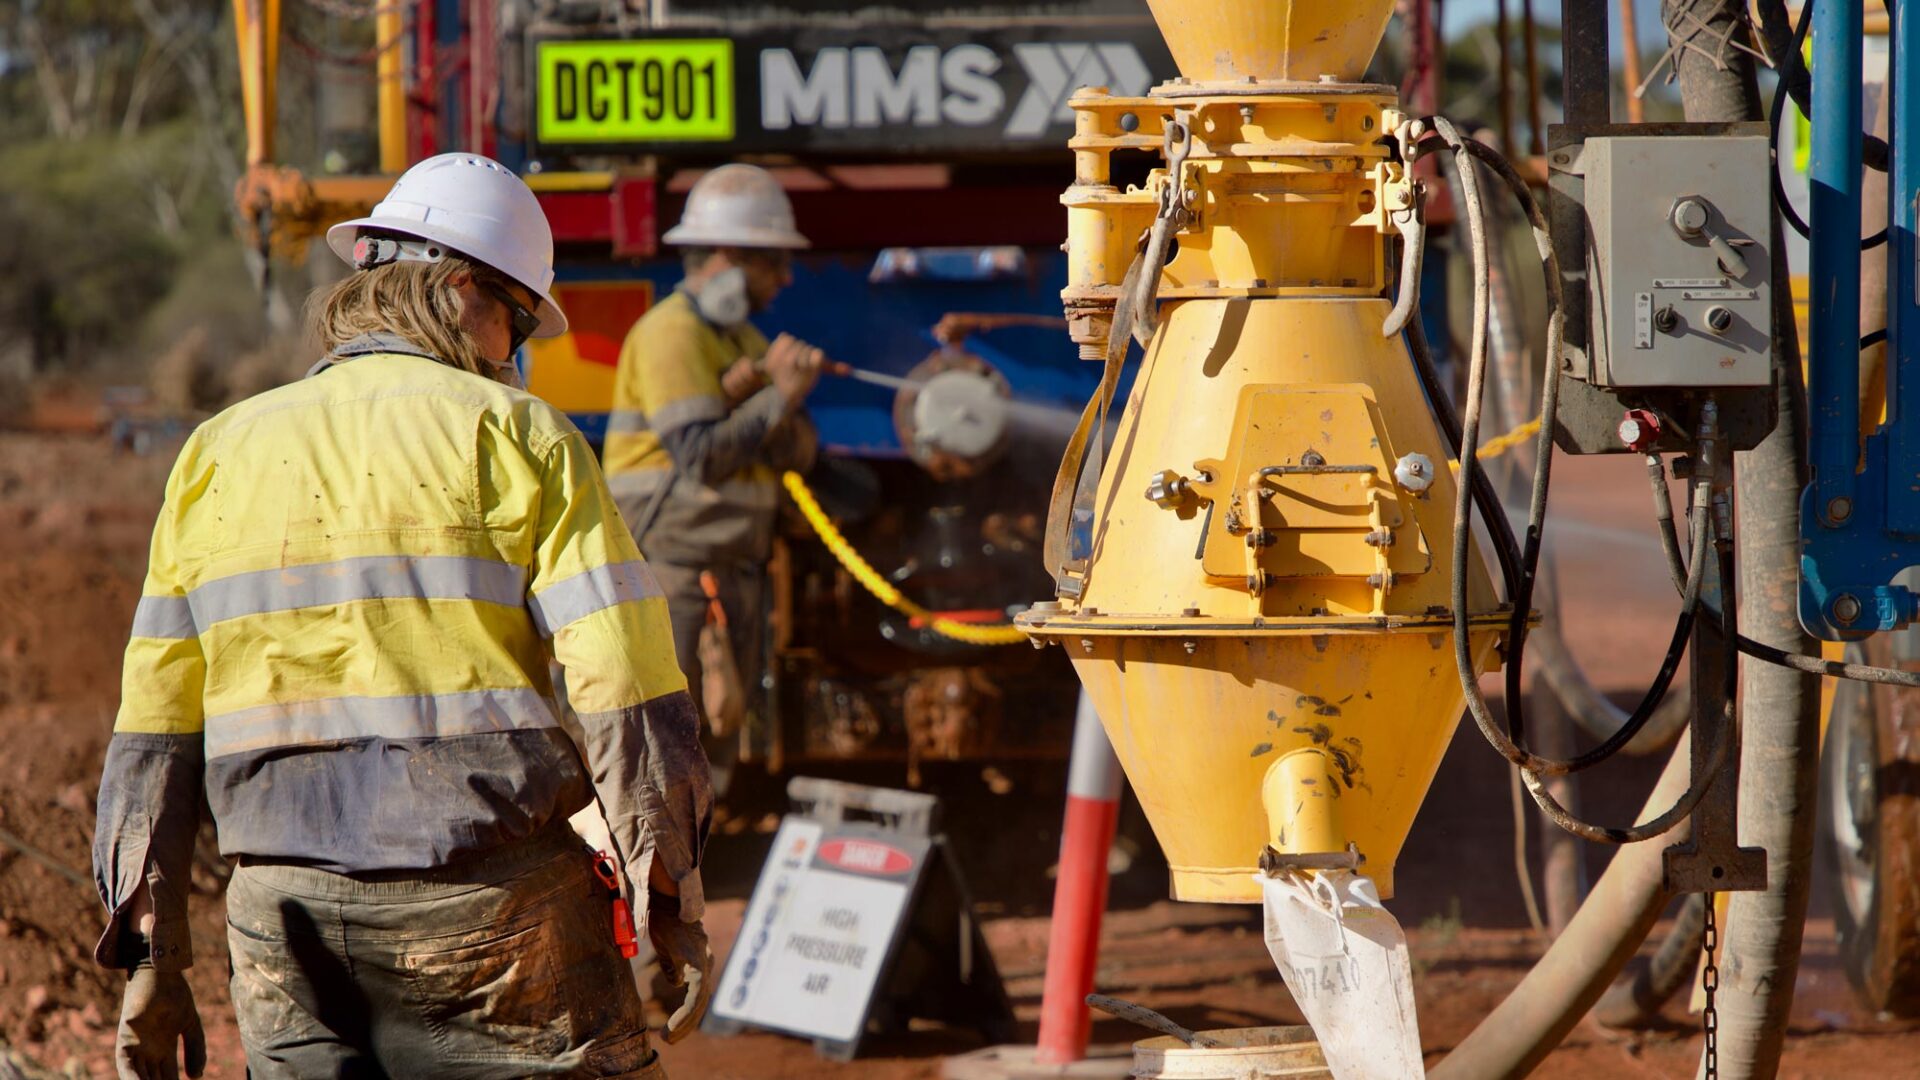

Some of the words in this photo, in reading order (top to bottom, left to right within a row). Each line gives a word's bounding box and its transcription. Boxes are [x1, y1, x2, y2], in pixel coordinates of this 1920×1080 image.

[553, 59, 719, 122] DCT901
[760, 45, 1005, 130] MMS
[821, 906, 859, 930] HIGH
[785, 932, 867, 969] PRESSURE
[802, 973, 831, 994] AIR
